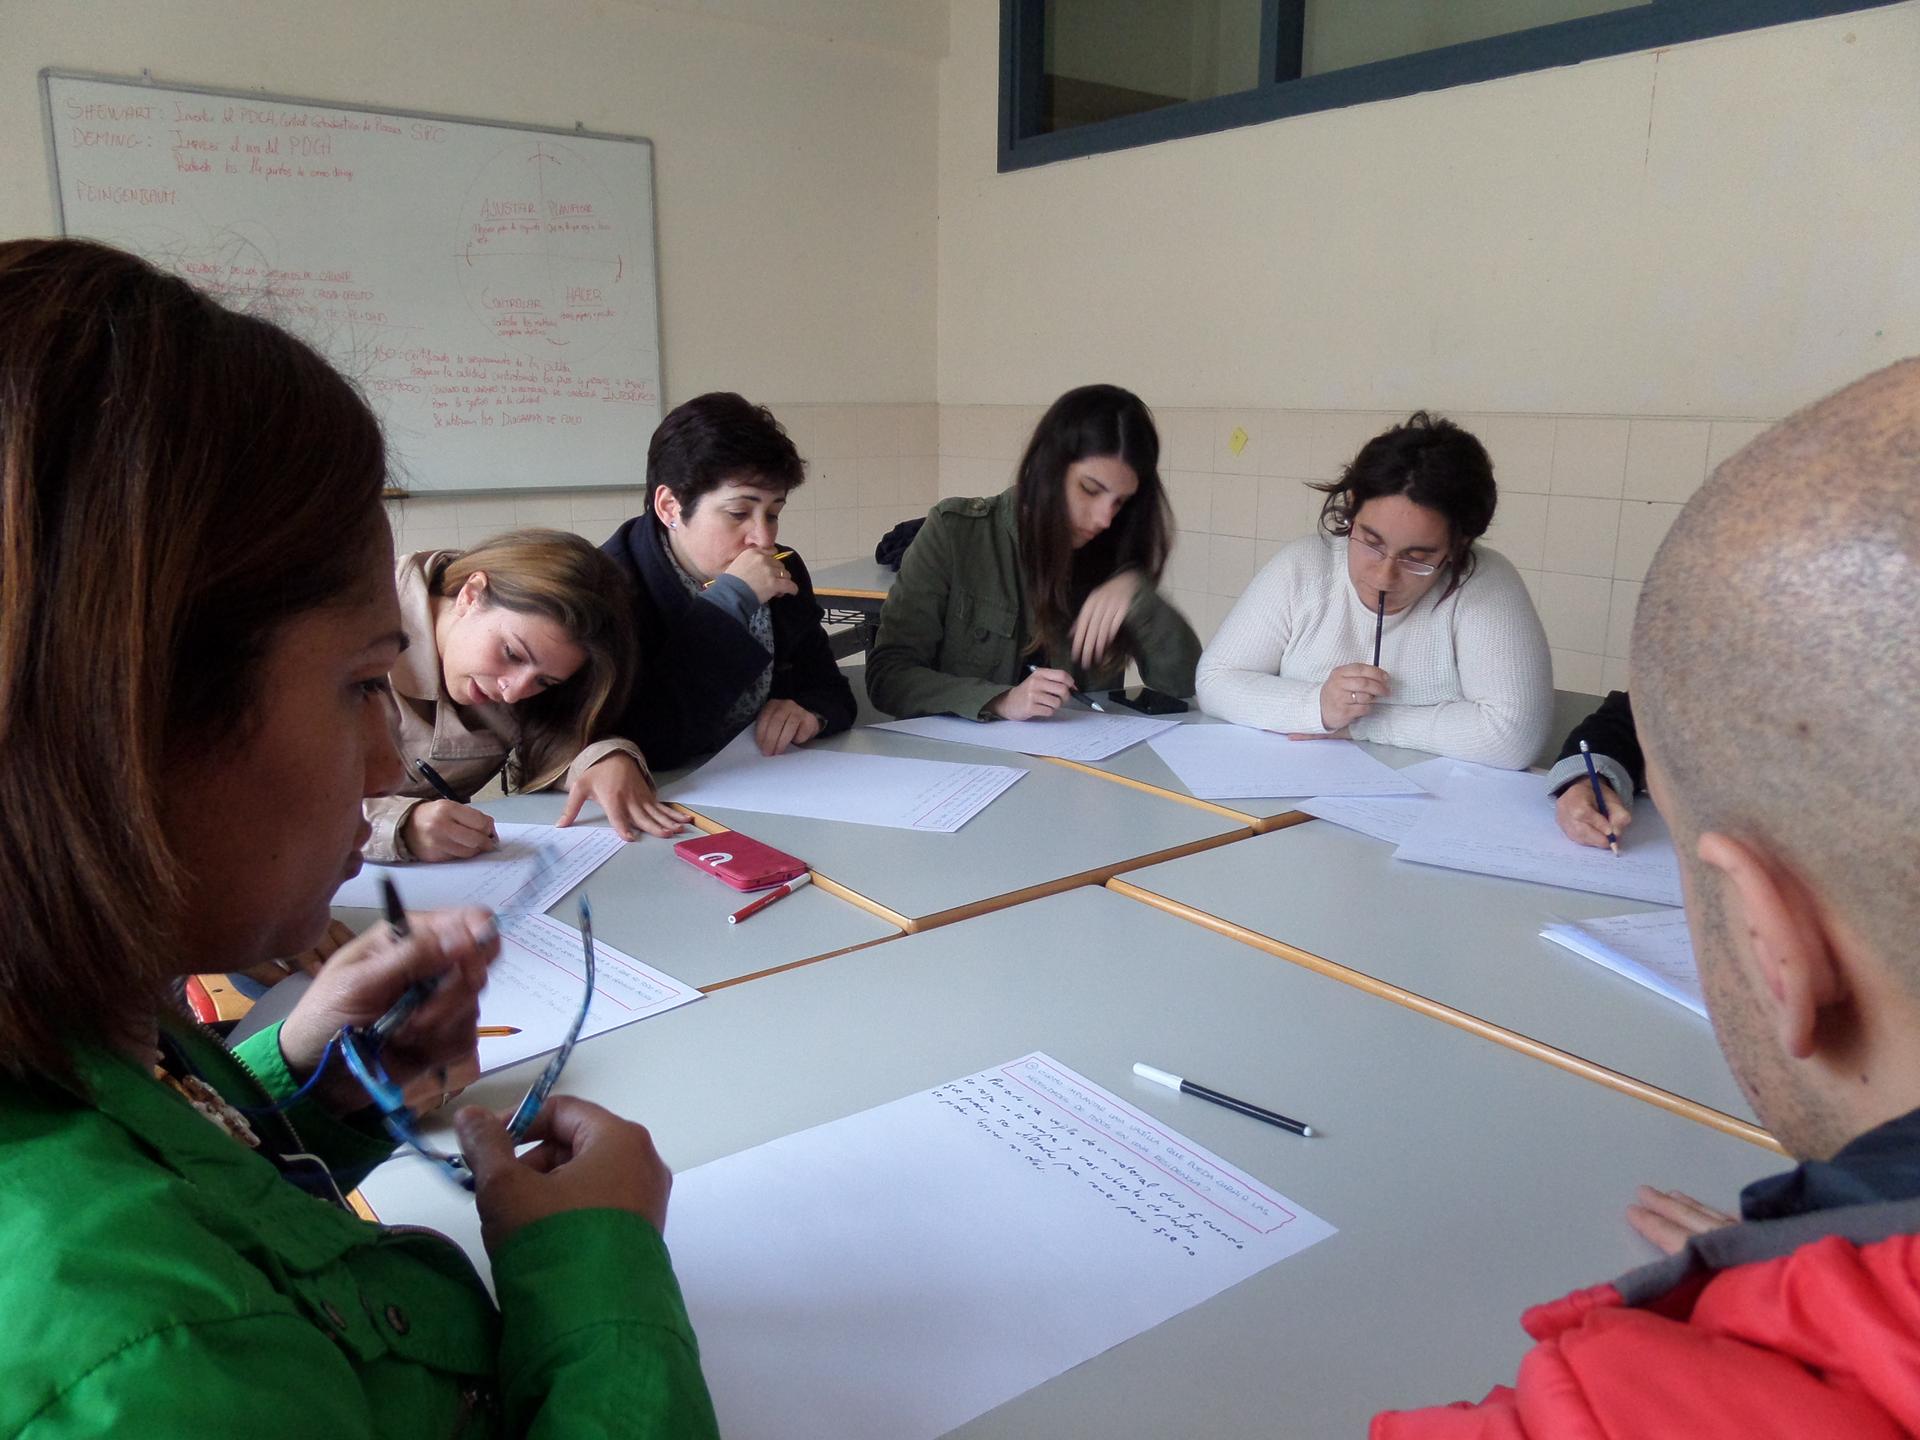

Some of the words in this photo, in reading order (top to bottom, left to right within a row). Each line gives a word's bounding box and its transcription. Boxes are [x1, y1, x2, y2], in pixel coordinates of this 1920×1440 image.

[481, 198, 535, 218] AJUSTAR
[481, 287, 543, 309] CONTROLAR
[566, 287, 603, 303] HACER
[1111, 1157, 1160, 1188] material
[1160, 1192, 1185, 1208] duro
[1166, 1146, 1184, 1160] QUE
[1187, 1160, 1214, 1181] PUEDA
[1251, 1202, 1270, 1216] LAS
[1115, 1206, 1147, 1223] pero
[1153, 1227, 1177, 1242] que
[1183, 1246, 1195, 1256] no
